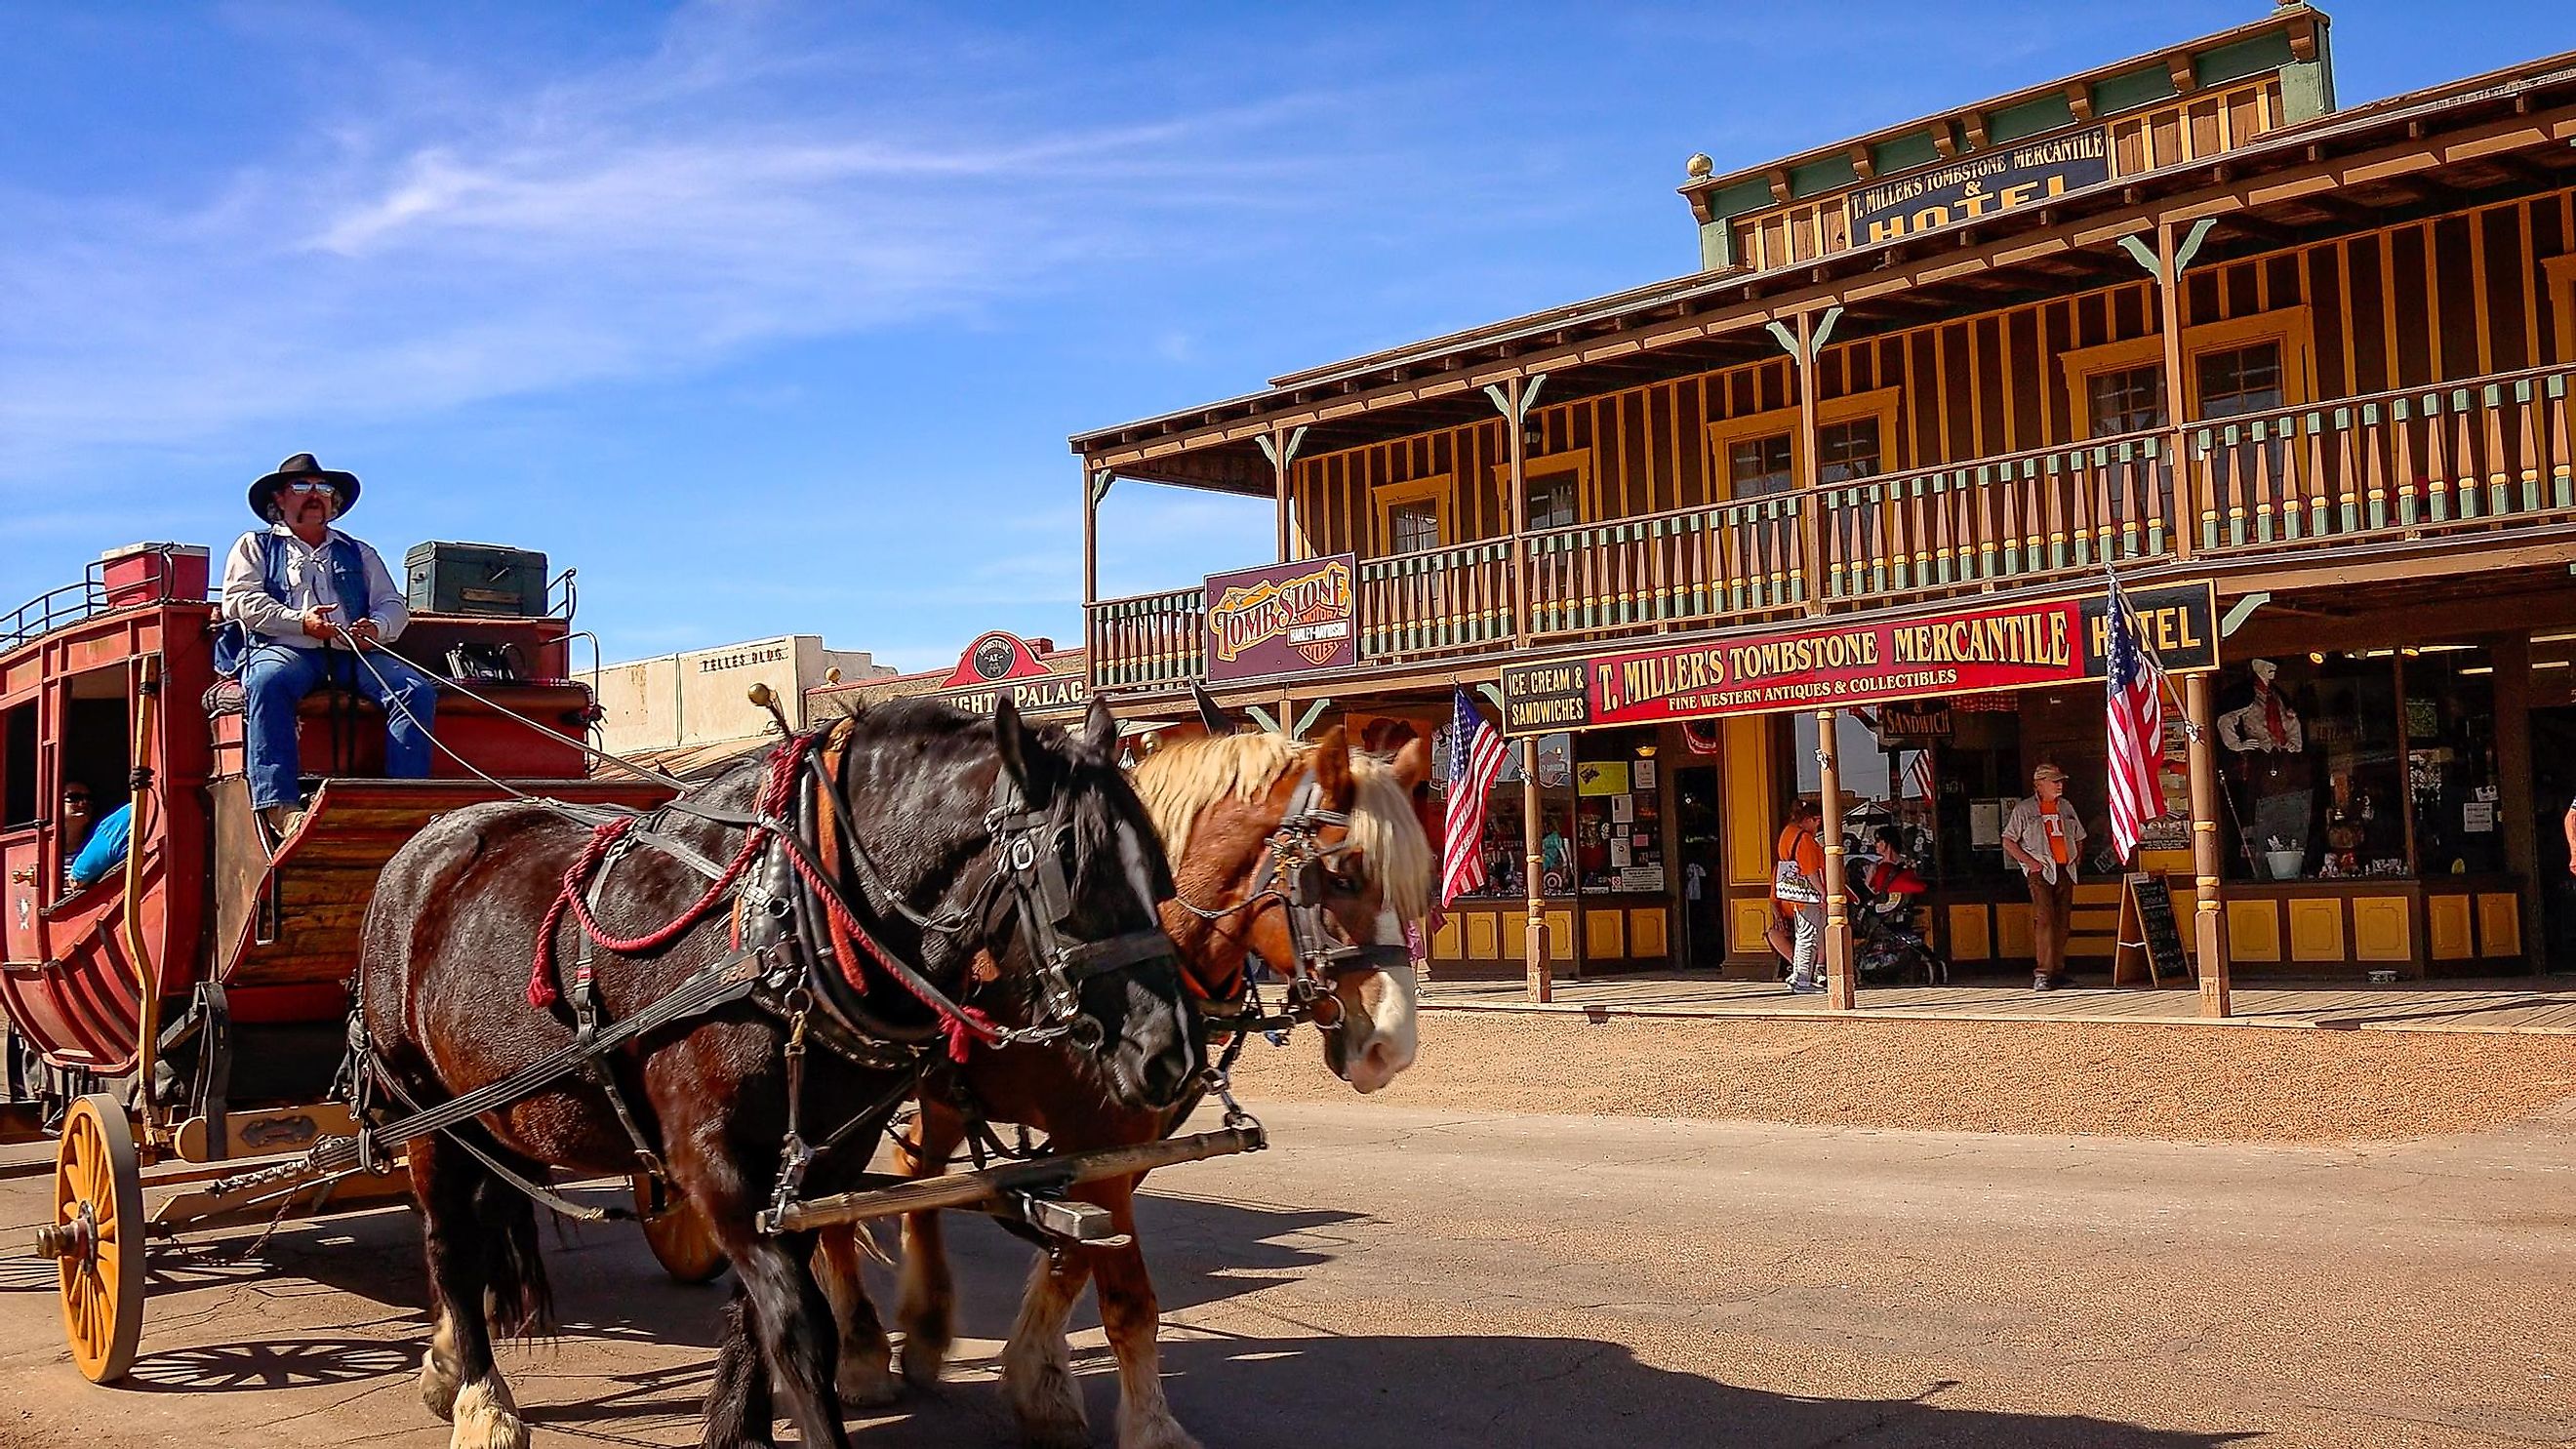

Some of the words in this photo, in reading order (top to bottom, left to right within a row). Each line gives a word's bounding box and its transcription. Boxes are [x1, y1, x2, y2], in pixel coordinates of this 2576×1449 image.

[1851, 198, 1864, 221] T.
[1866, 176, 1923, 215] MILLER'S
[1925, 155, 2007, 191] TOMBSTONE
[2013, 131, 2105, 170] MERCANTILE
[1963, 180, 1982, 197] &
[1213, 569, 1350, 655] TOMBSTONE
[2091, 605, 2202, 658] HTEL
[1598, 664, 1619, 712] T.
[1623, 649, 1725, 705] MILLER'S
[1728, 631, 1880, 681] TOMBSTONE
[1893, 610, 2071, 667] MERCANTILE
[1013, 680, 1090, 709] PALAC
[1508, 672, 1526, 697] ICE
[1530, 667, 1570, 695] CREAM
[1574, 665, 1585, 690] &
[1669, 694, 1698, 711] FINE
[1700, 688, 1762, 709] WESTERN
[1764, 681, 1832, 702] ANTIQUES
[1834, 678, 1847, 695] &
[1849, 668, 1958, 694] COLLECTIBLES
[1512, 697, 1586, 727] SANDWICHES
[1885, 708, 1951, 735] SANDWICH
